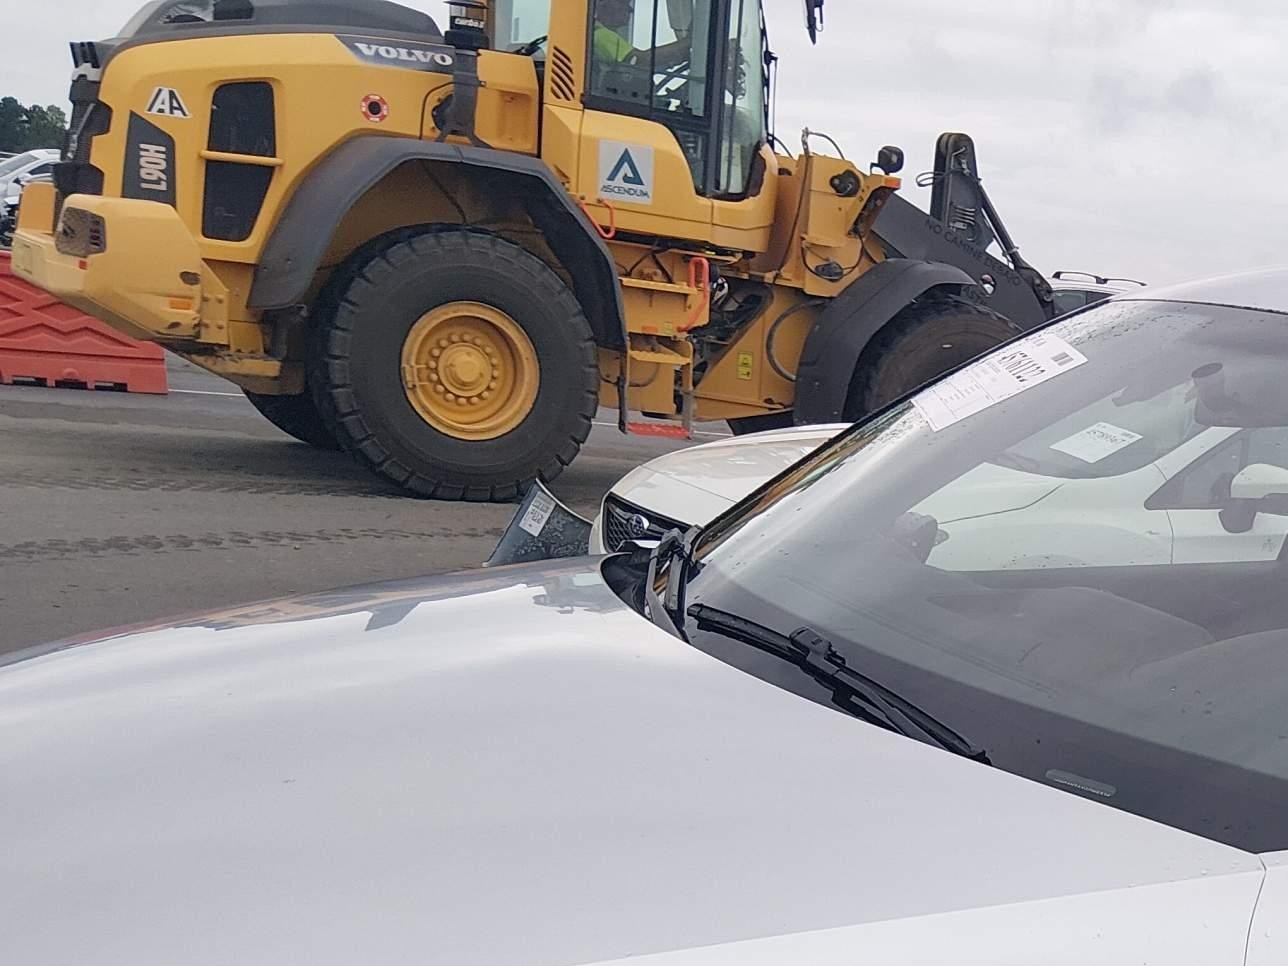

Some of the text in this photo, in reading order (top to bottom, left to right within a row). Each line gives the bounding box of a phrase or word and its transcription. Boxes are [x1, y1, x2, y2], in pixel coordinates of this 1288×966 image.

[354, 42, 453, 65] VOLVO
[139, 143, 168, 191] L90H
[600, 184, 650, 199] ASCENDUM
